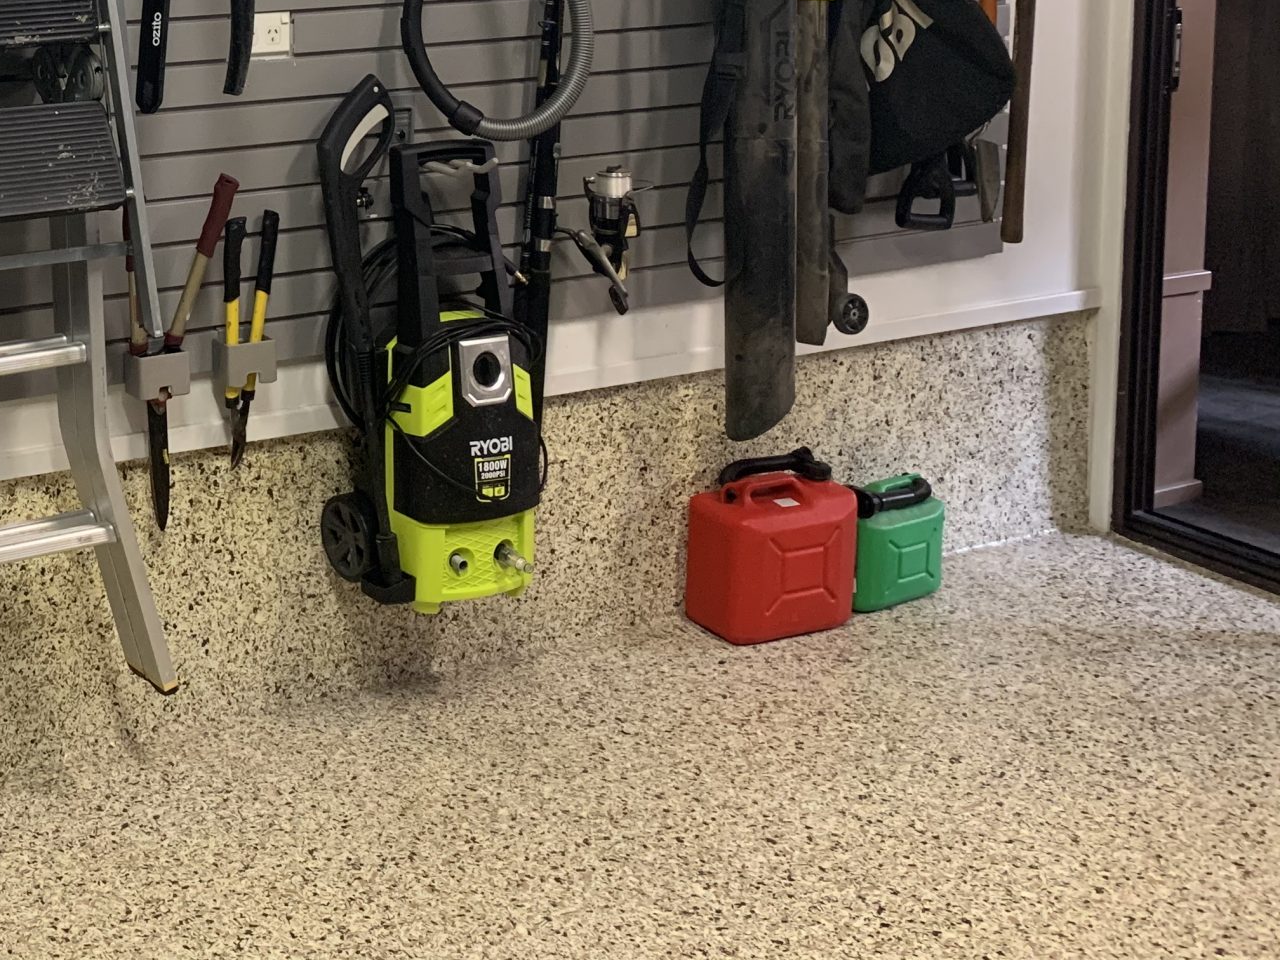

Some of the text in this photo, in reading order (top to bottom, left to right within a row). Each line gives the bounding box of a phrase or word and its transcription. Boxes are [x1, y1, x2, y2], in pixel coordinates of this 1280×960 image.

[152, 11, 162, 47] ozito
[469, 435, 513, 457] RYOBI
[478, 459, 508, 472] 1800W
